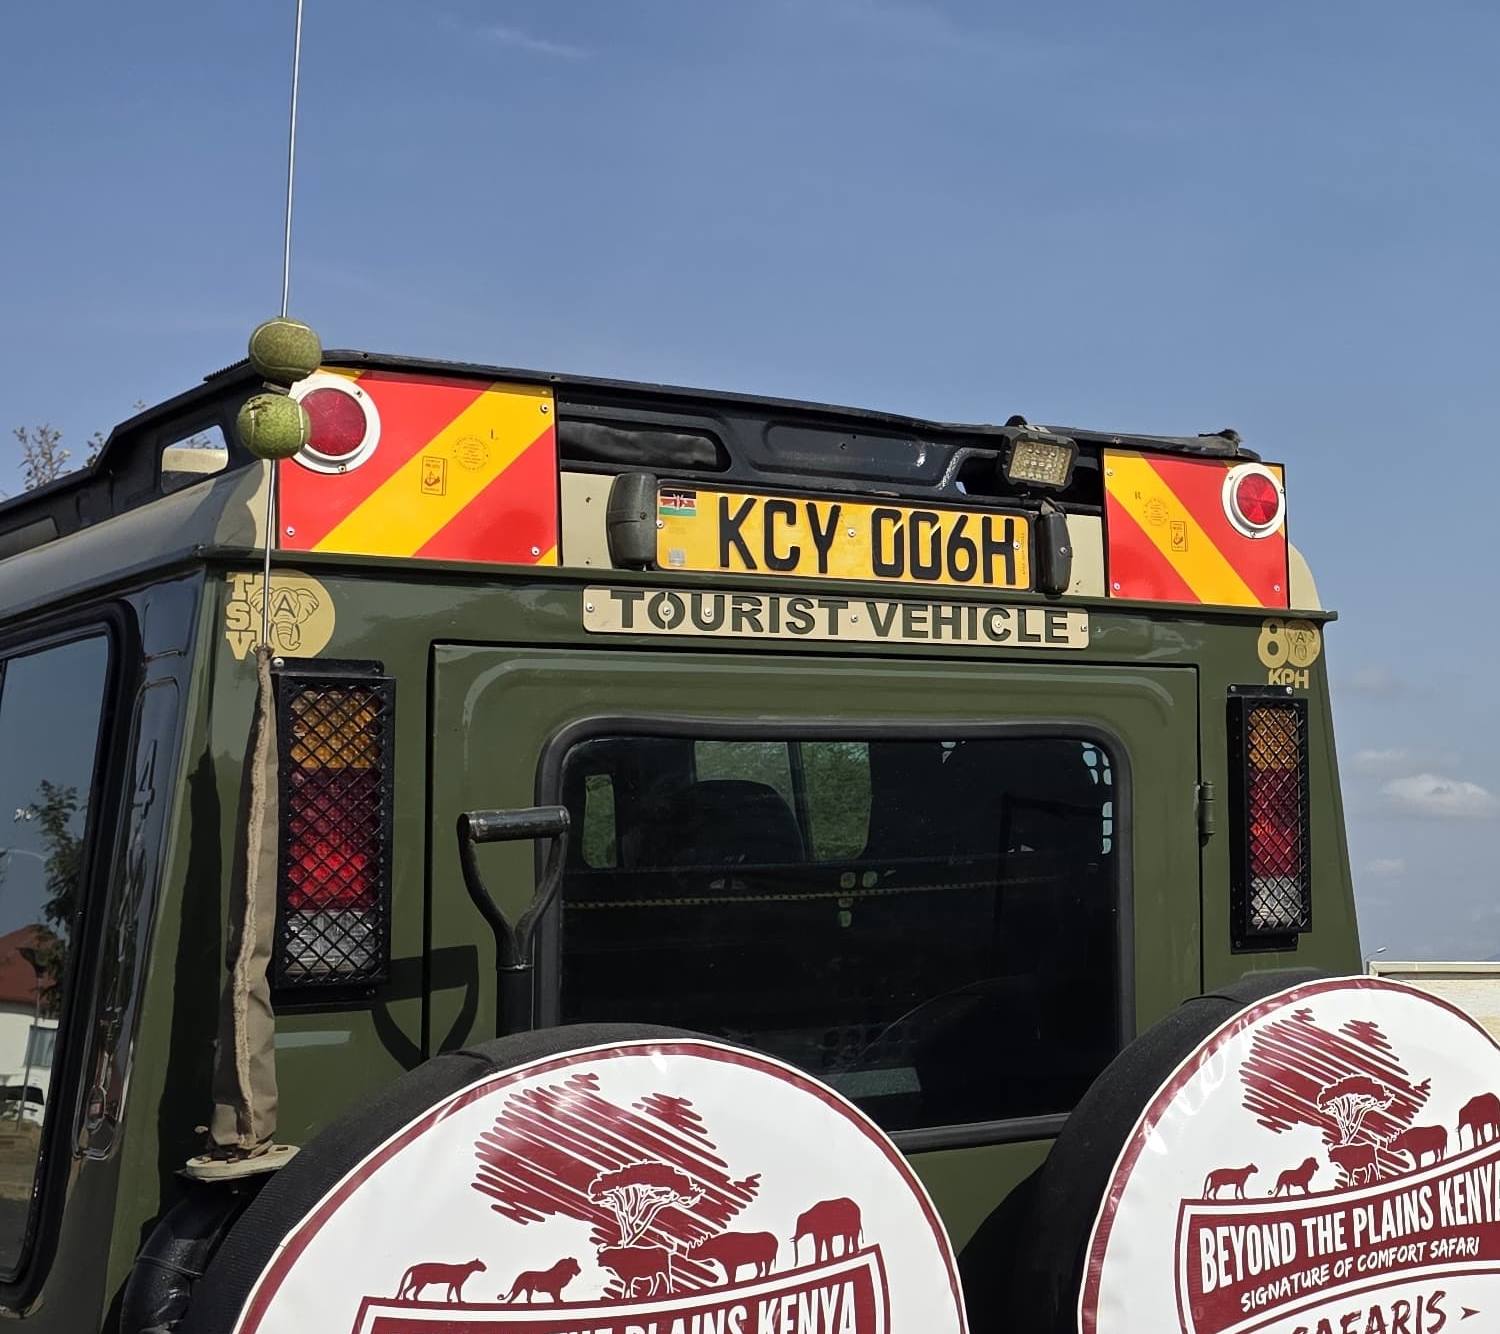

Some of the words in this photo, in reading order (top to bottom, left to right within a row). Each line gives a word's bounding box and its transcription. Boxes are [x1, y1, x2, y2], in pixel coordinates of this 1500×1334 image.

[717, 496, 842, 574] KCY
[871, 507, 1016, 585] 006H
[610, 589, 849, 636] TOURIST
[866, 602, 1070, 644] VEHICLE
[1268, 668, 1310, 689] KPH
[1199, 1222, 1297, 1294] BEYOND
[1302, 1211, 1348, 1257] THE
[1353, 1186, 1434, 1248] PLAINS
[1241, 1263, 1330, 1312] SIGNATURE
[1334, 1257, 1353, 1278] OF
[1357, 1242, 1428, 1272] COMFORT
[1430, 1236, 1480, 1258] SAFARI
